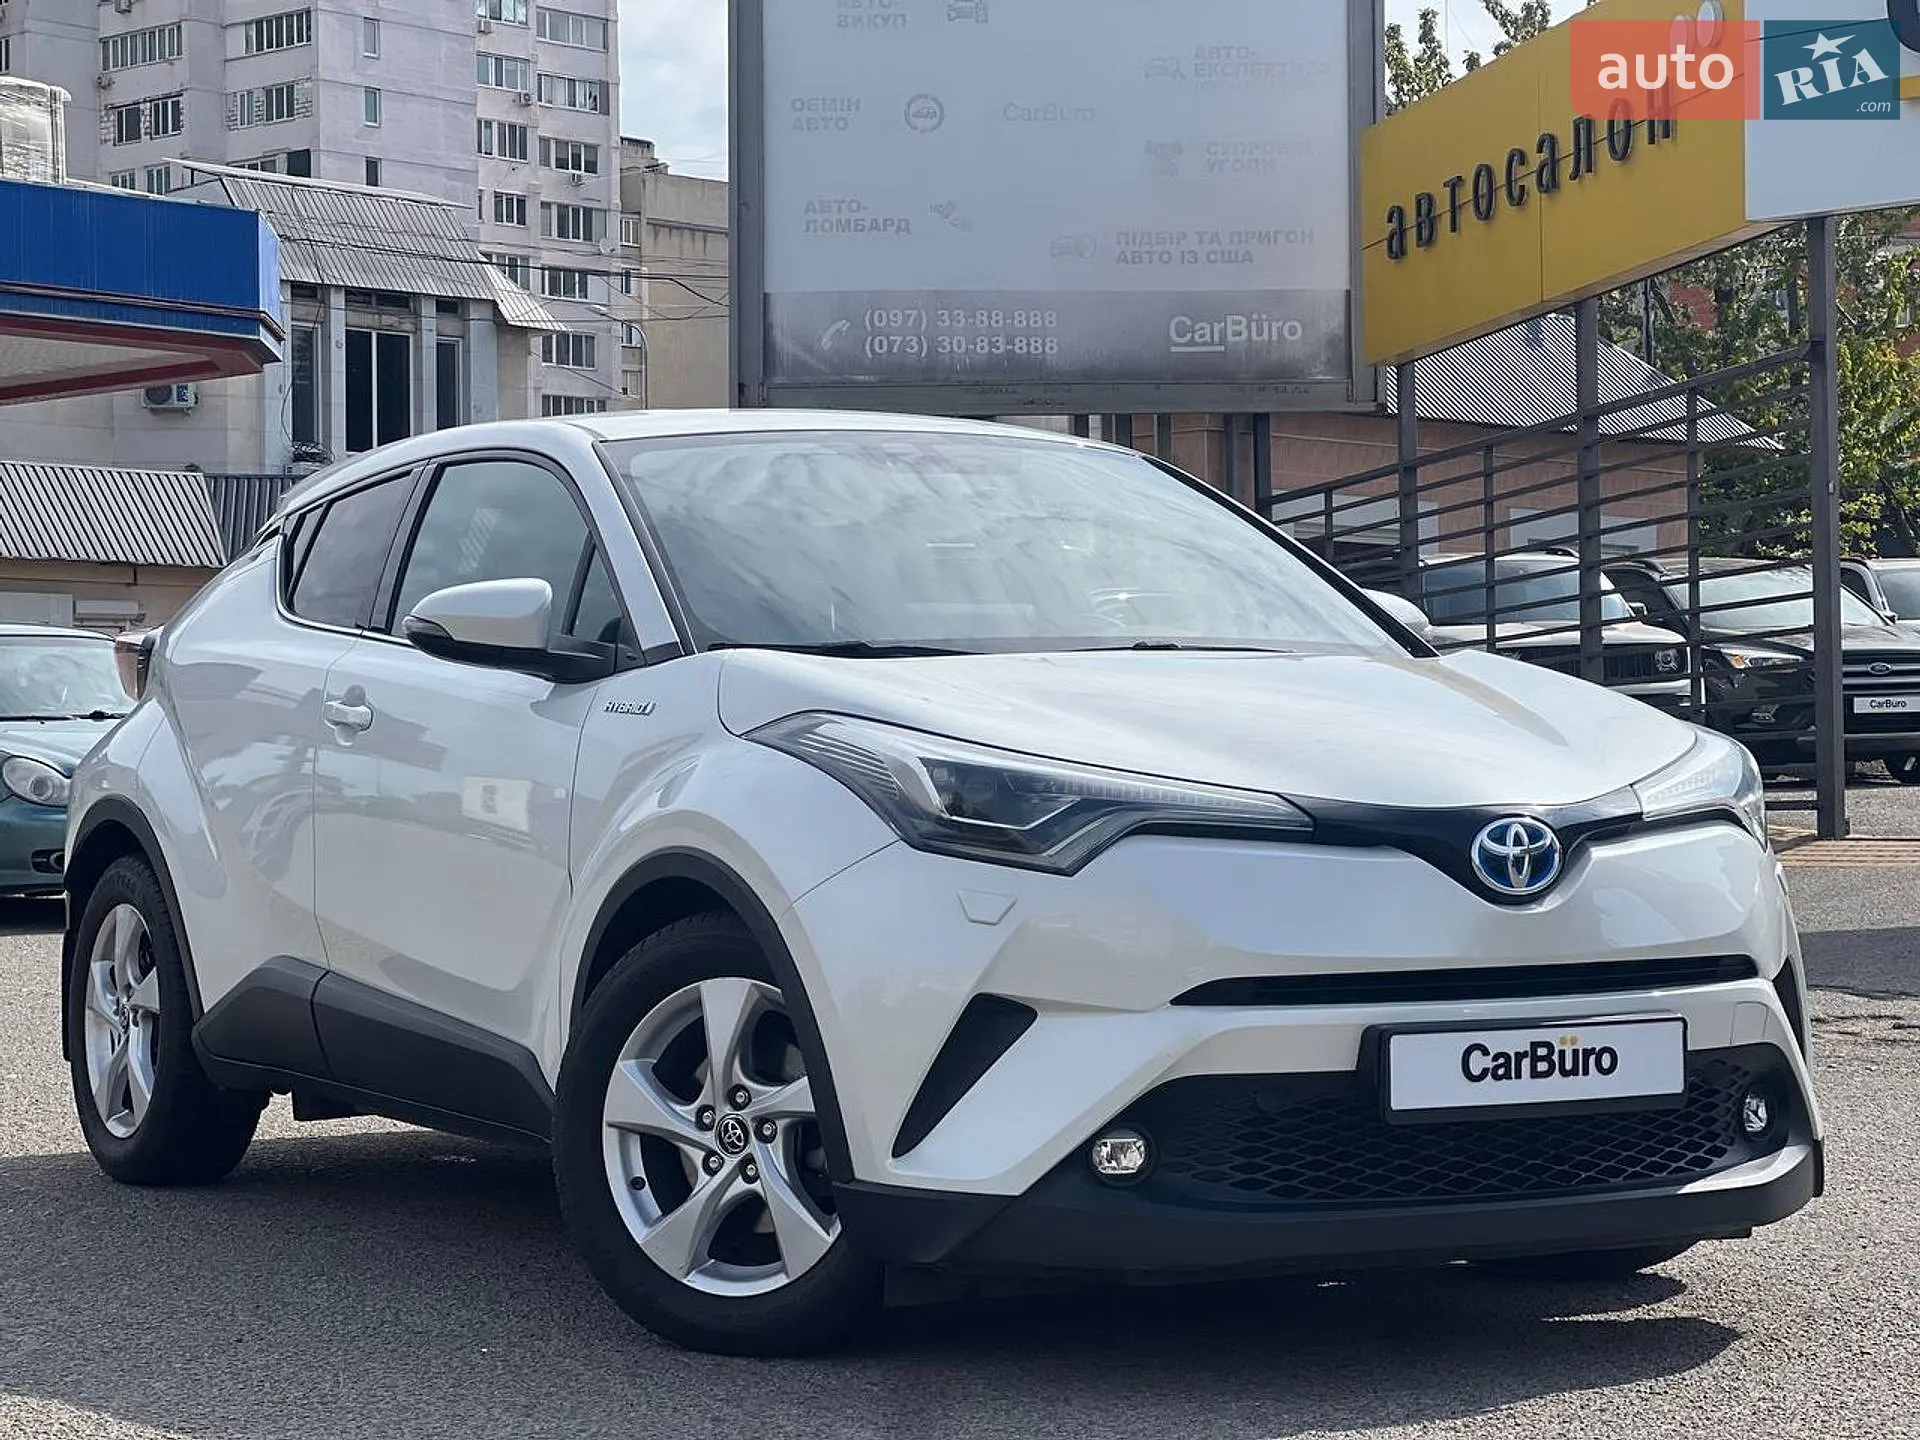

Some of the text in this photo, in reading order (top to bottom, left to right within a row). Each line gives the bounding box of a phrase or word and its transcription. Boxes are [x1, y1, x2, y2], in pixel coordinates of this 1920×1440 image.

[837, 14, 907, 28] ВИКУП
[790, 98, 861, 112] ОБМІН
[790, 117, 850, 131] АВТО
[1386, 78, 1673, 260] автосалон
[803, 200, 869, 214] АВТО-
[803, 218, 912, 234] ЛОМБАРД
[1116, 230, 1314, 248] ПІДБІР ТА ПРИГОН
[1116, 250, 1254, 265] АВТО ІЗ США
[864, 310, 1058, 332] (097) 33-88-888
[1169, 313, 1303, 343] CarBüro
[864, 336, 1059, 357] (073) 30-83-888
[1461, 1035, 1618, 1082] CarBüro
